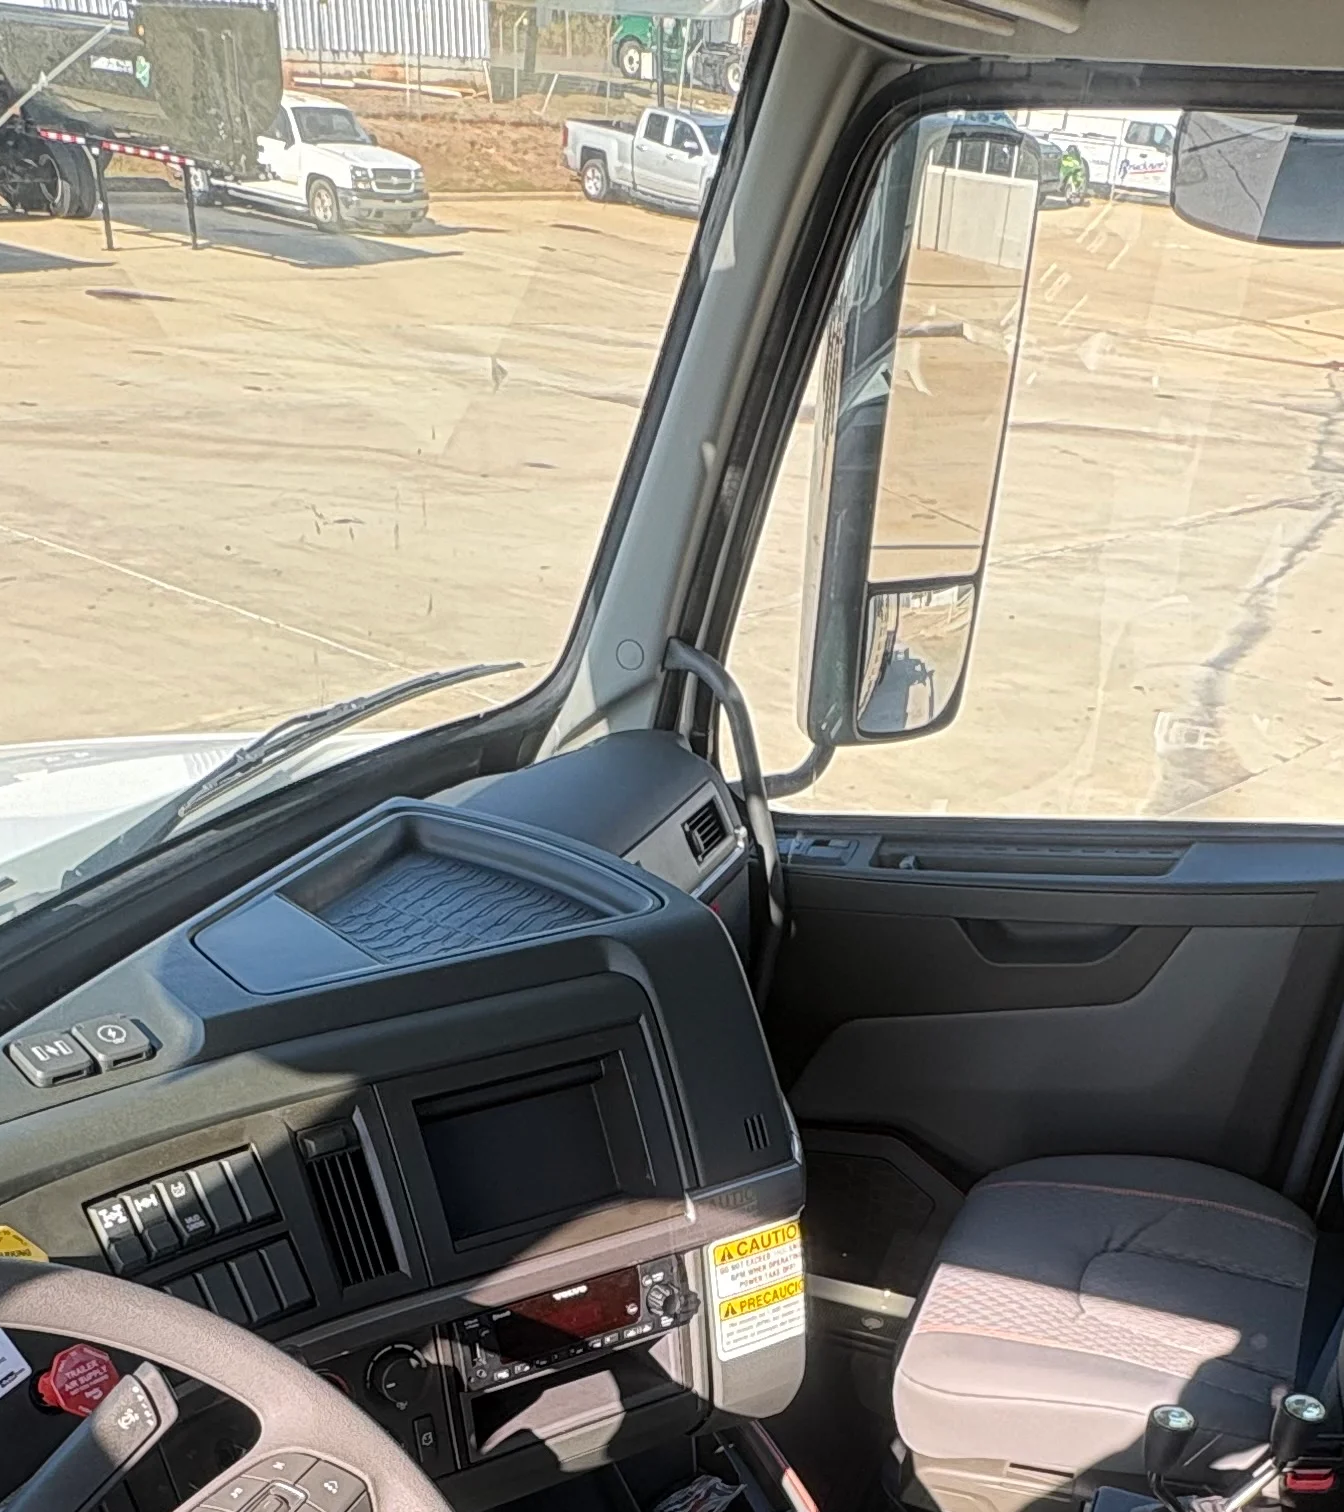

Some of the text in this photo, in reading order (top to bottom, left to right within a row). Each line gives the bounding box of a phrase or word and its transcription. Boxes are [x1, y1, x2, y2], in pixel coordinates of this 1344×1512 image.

[736, 1223, 797, 1257] CAUTIO
[744, 1251, 771, 1266] EXCEED
[767, 1251, 802, 1268] OPERATIN
[738, 1274, 763, 1288] POWER
[552, 1285, 588, 1301] VOLVO
[64, 1358, 99, 1380] TRAILER
[76, 1363, 109, 1385] SUPPLY
